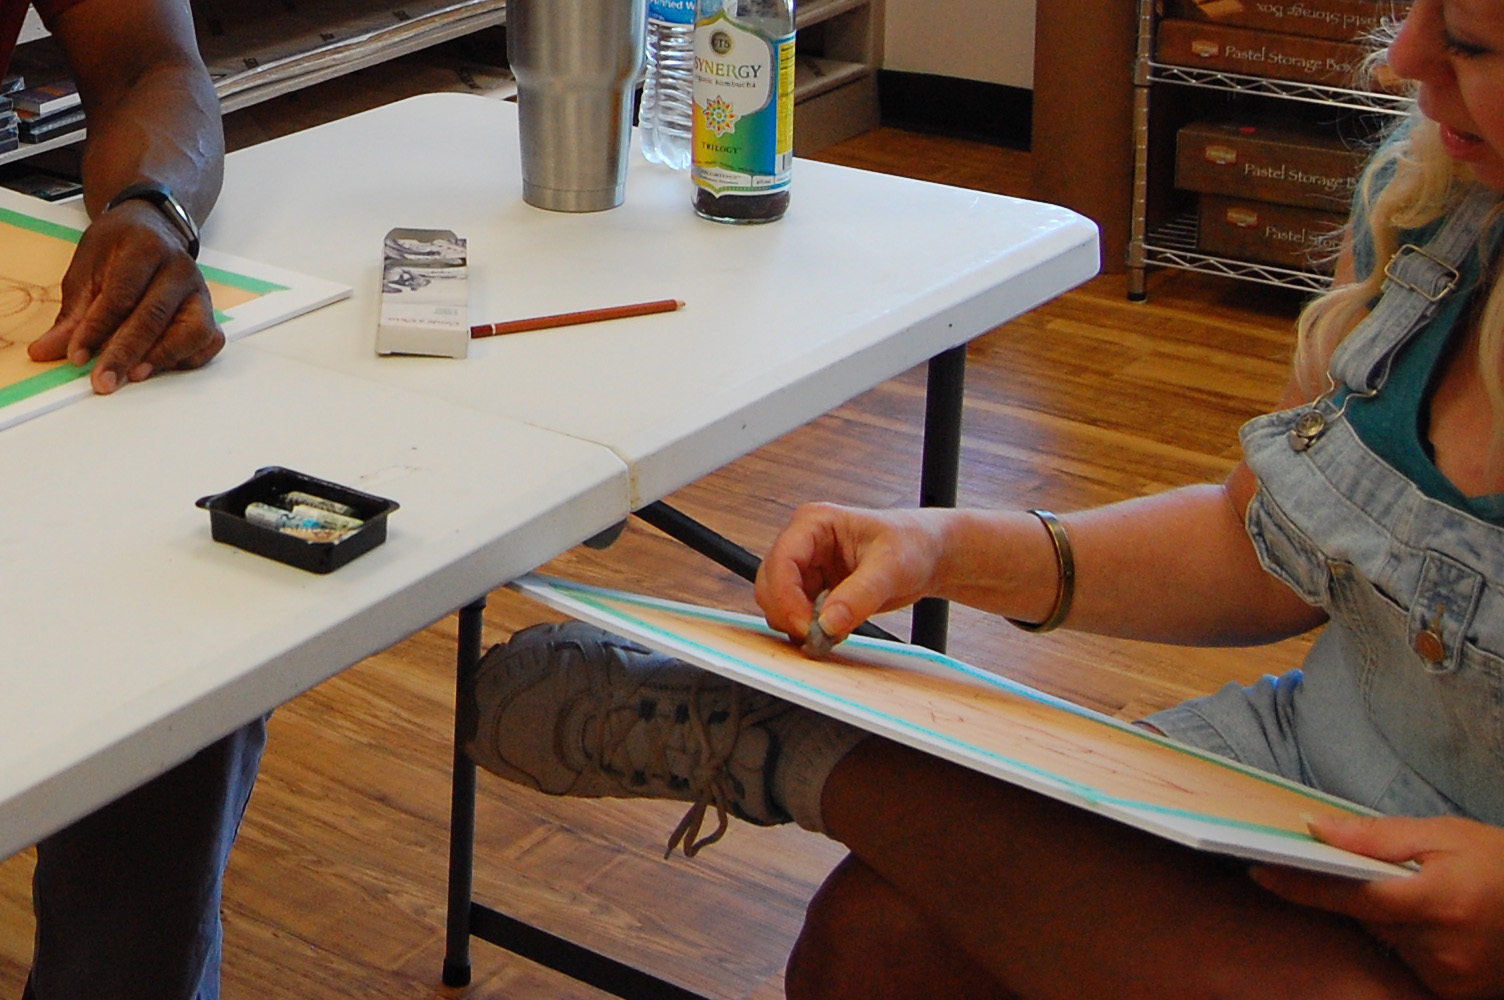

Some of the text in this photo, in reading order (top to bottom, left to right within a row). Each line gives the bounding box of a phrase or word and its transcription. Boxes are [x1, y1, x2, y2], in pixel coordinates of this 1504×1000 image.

[1257, 2, 1376, 30] astel Storage Box
[695, 56, 762, 80] SYNERGY
[1225, 46, 1267, 63] Pastel
[1269, 51, 1323, 73] Storage
[702, 142, 738, 154] TRILOGY
[1245, 162, 1286, 181] Pastel
[1288, 169, 1343, 192] Storage
[1265, 225, 1306, 244] Pastel
